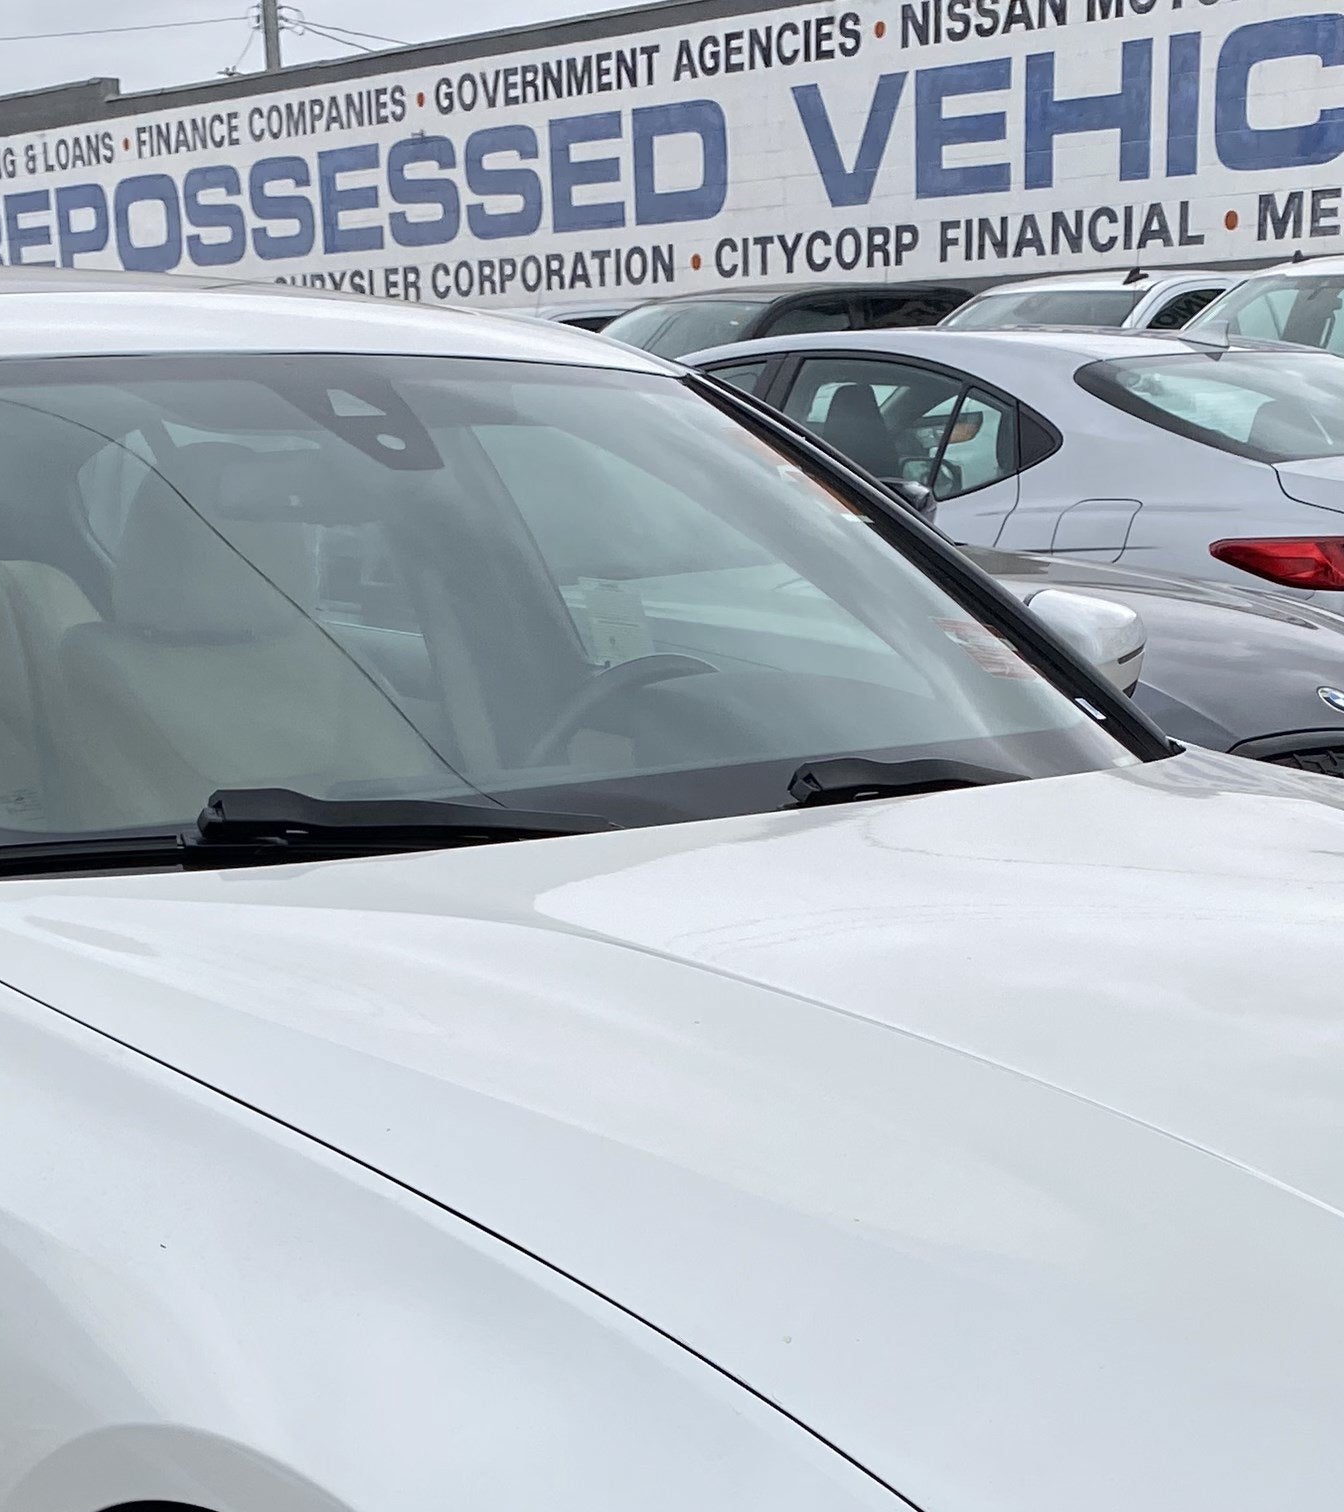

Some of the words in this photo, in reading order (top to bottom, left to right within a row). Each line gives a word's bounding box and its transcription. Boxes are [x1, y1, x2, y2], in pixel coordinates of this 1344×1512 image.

[25, 145, 37, 174] &
[44, 132, 115, 172] LOANS
[137, 111, 240, 158] FINANCE
[249, 85, 406, 141] COMPANIES
[435, 45, 660, 115] GOVERNMENT
[673, 12, 862, 82] AGENCIES
[901, 0, 1067, 49] NISSAN
[275, 265, 421, 302] YSLER
[431, 242, 676, 300] CORPORATION
[714, 224, 918, 280] CITYCORP
[939, 202, 1205, 264] FINANCIAL
